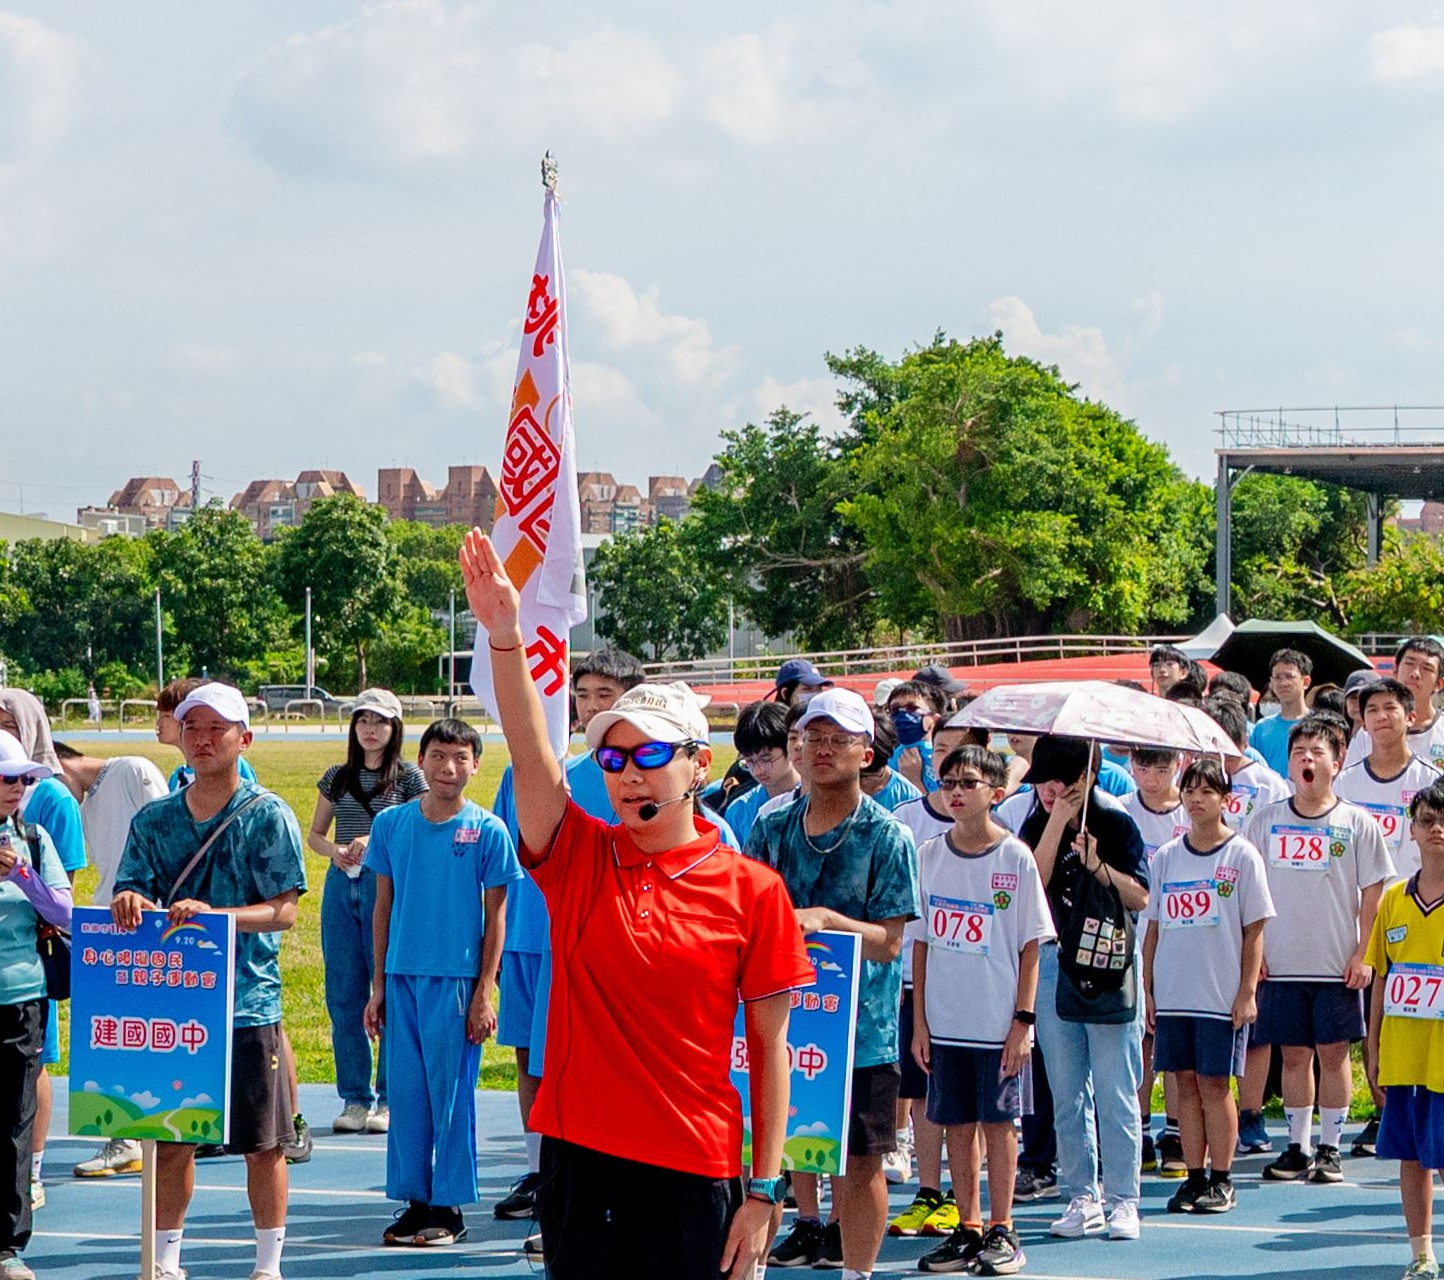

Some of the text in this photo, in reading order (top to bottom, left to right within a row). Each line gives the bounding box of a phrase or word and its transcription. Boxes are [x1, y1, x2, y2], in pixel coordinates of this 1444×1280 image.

[1278, 835, 1323, 861] 128
[1167, 890, 1211, 919] 089
[174, 936, 195, 945] 9.20
[933, 909, 984, 943] 078
[1390, 975, 1442, 1007] 027
[90, 1015, 209, 1055] 建國國中
